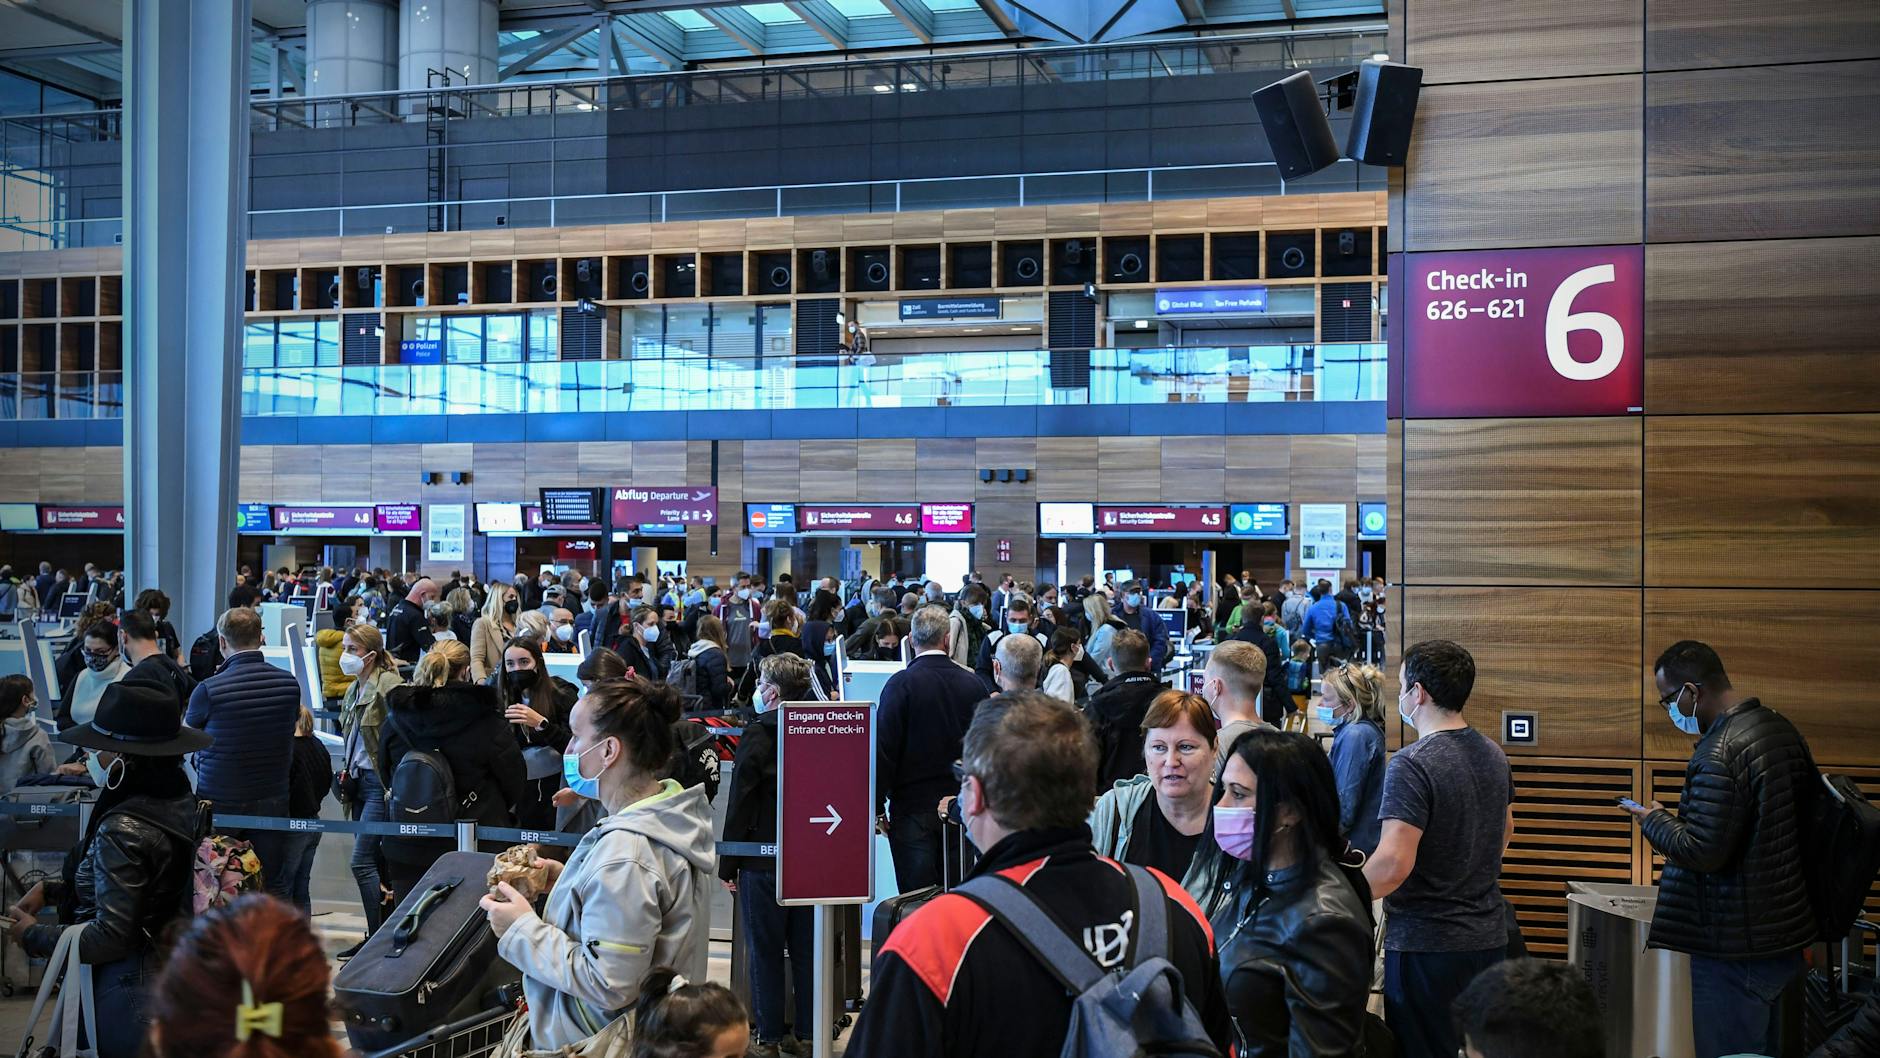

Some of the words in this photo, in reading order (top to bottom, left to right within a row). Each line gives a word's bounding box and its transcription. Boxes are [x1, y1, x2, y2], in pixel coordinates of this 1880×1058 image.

[1427, 268, 1528, 290] Check-in
[1545, 263, 1625, 381] 6
[416, 342, 438, 350] Polizei
[615, 489, 649, 502] Abflug
[650, 491, 689, 502] Departure
[354, 513, 370, 524] 4.8
[660, 509, 680, 518] Priority
[895, 513, 913, 524] 4.6
[1201, 513, 1221, 525] 4.5
[788, 711, 824, 722] Eingang
[826, 711, 864, 721] Check-in
[788, 725, 826, 734] Entrance
[828, 724, 865, 734] Check-in
[31, 804, 47, 815] BER
[290, 820, 307, 830] BER
[400, 824, 418, 835] BER
[520, 831, 539, 842] BER
